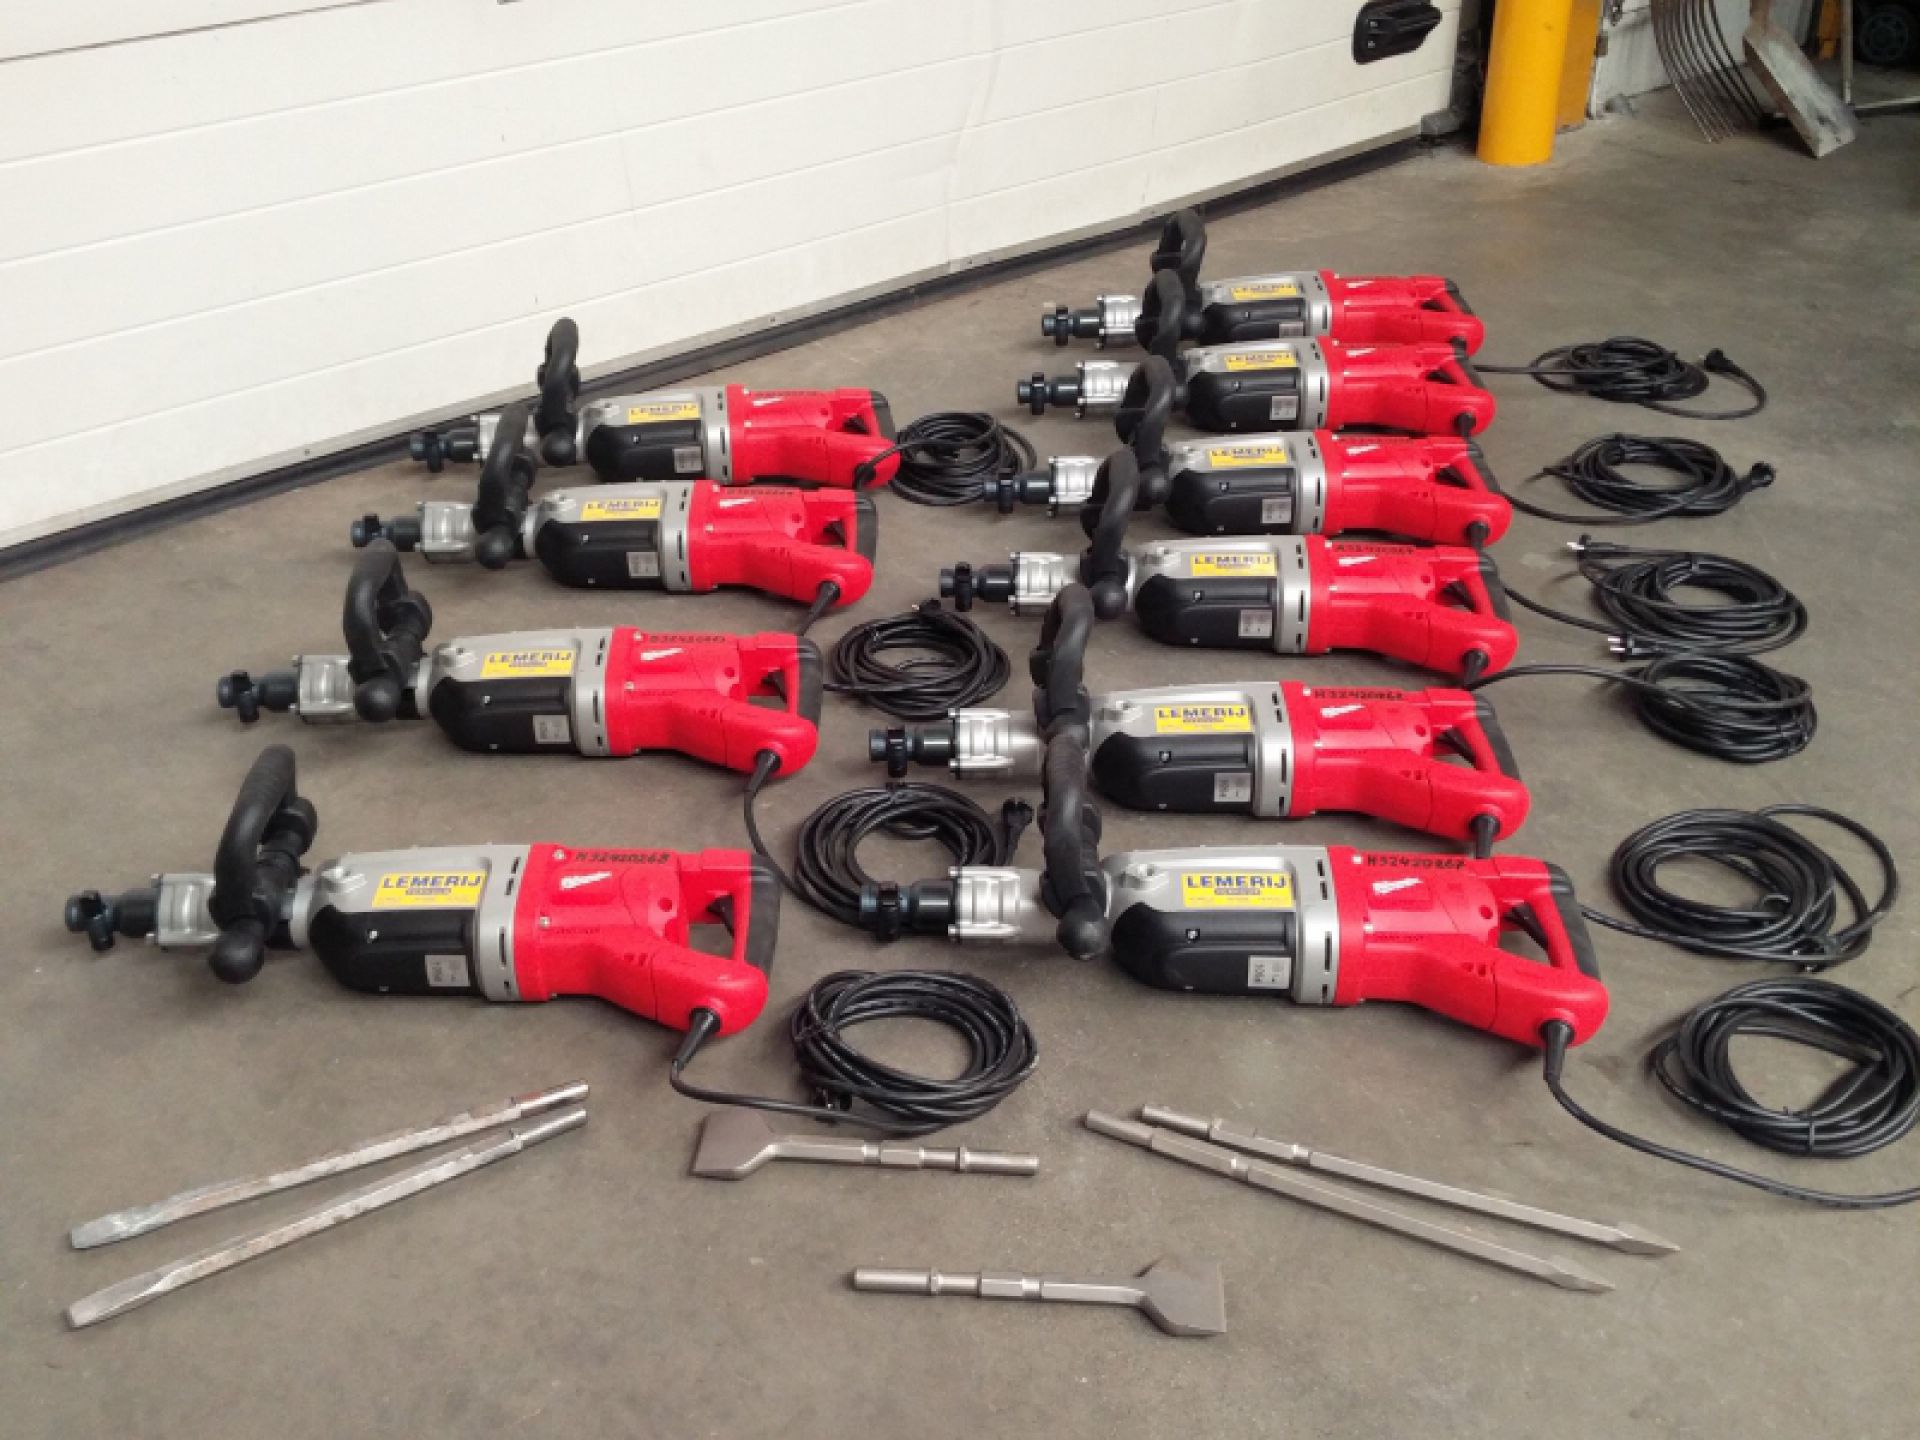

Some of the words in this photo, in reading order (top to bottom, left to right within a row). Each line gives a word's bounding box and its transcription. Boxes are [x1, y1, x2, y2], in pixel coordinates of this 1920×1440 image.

[489, 652, 572, 663] LEMERIJ
[1158, 706, 1246, 718] LEMERIJ
[382, 875, 482, 889] LEMERIJ
[1187, 875, 1287, 889] LEMERIJ
